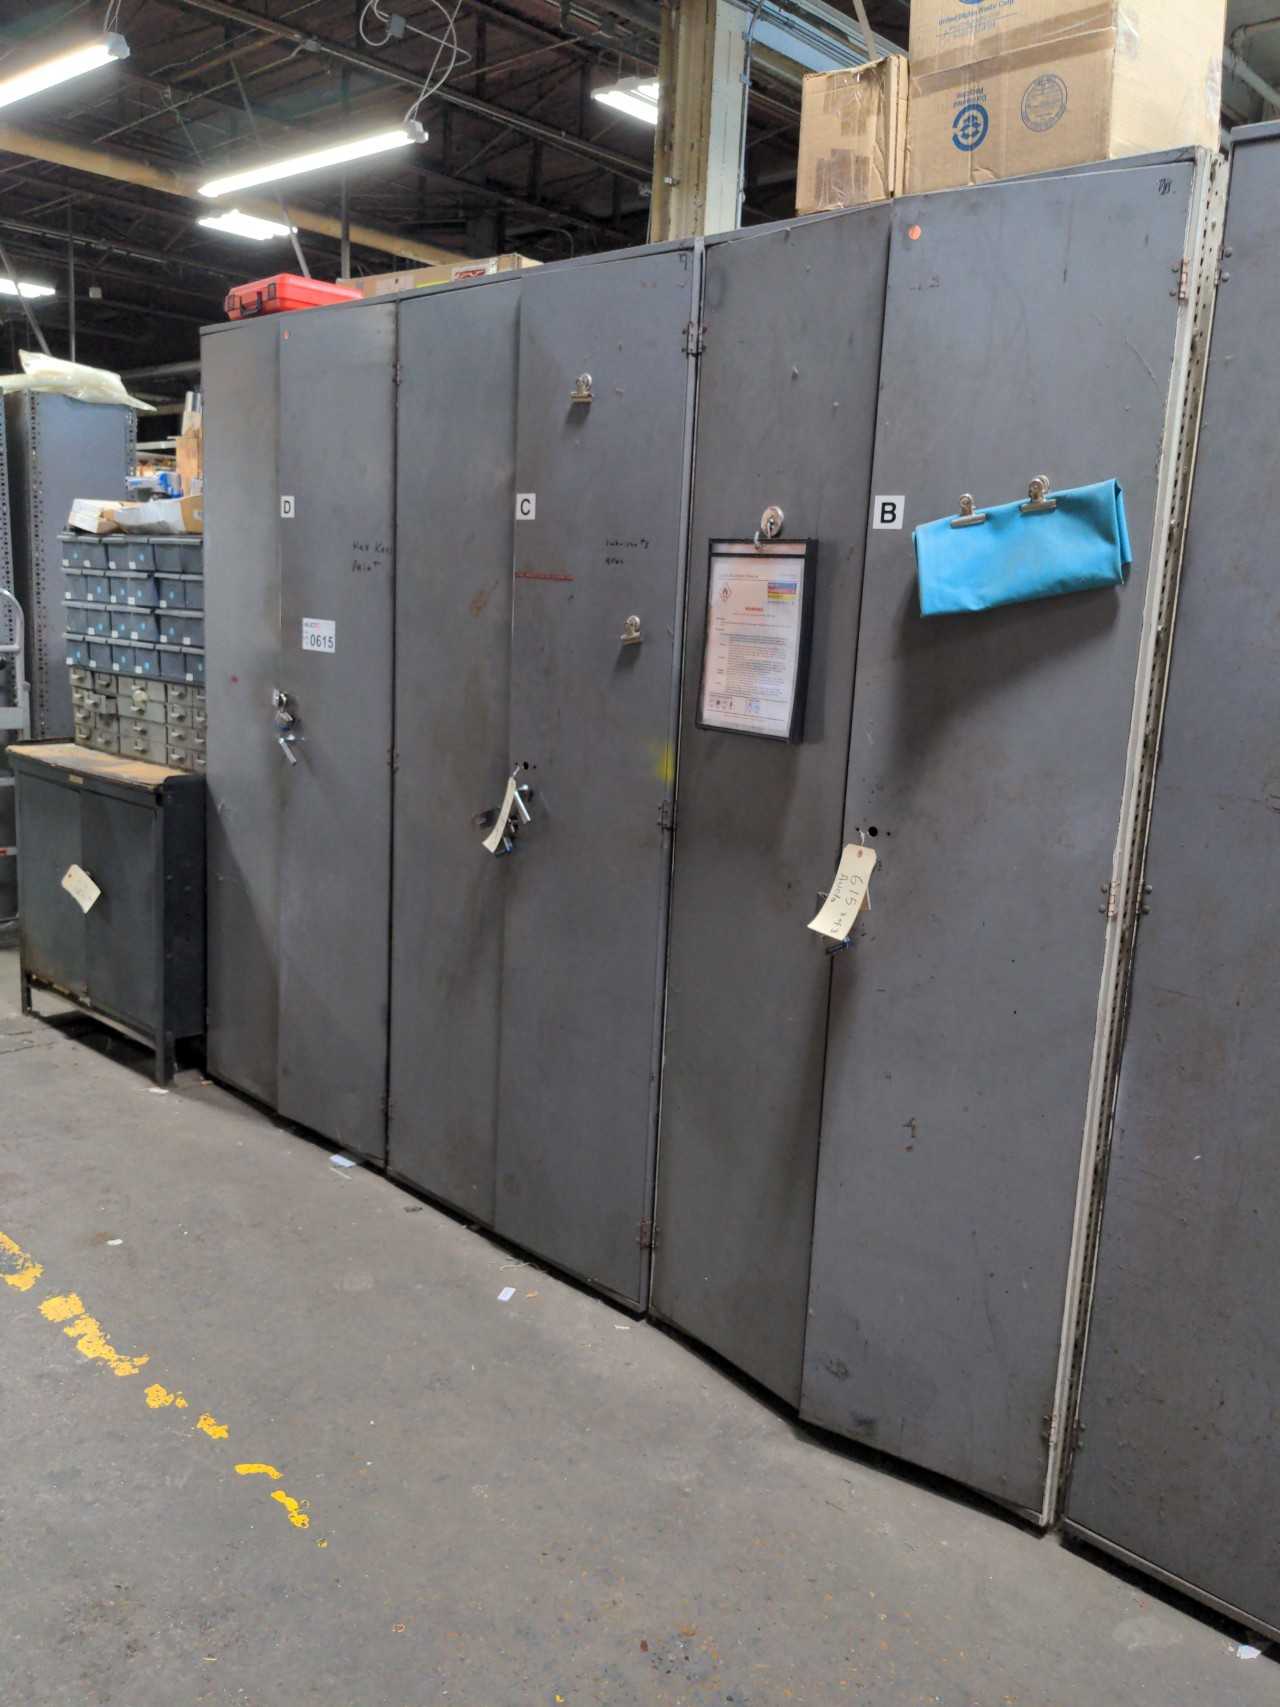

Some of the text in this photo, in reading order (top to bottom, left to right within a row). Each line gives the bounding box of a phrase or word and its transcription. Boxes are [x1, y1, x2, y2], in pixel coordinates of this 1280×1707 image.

[283, 500, 291, 514] D
[520, 498, 531, 516] C
[880, 502, 897, 523] B
[310, 633, 334, 649] 0615
